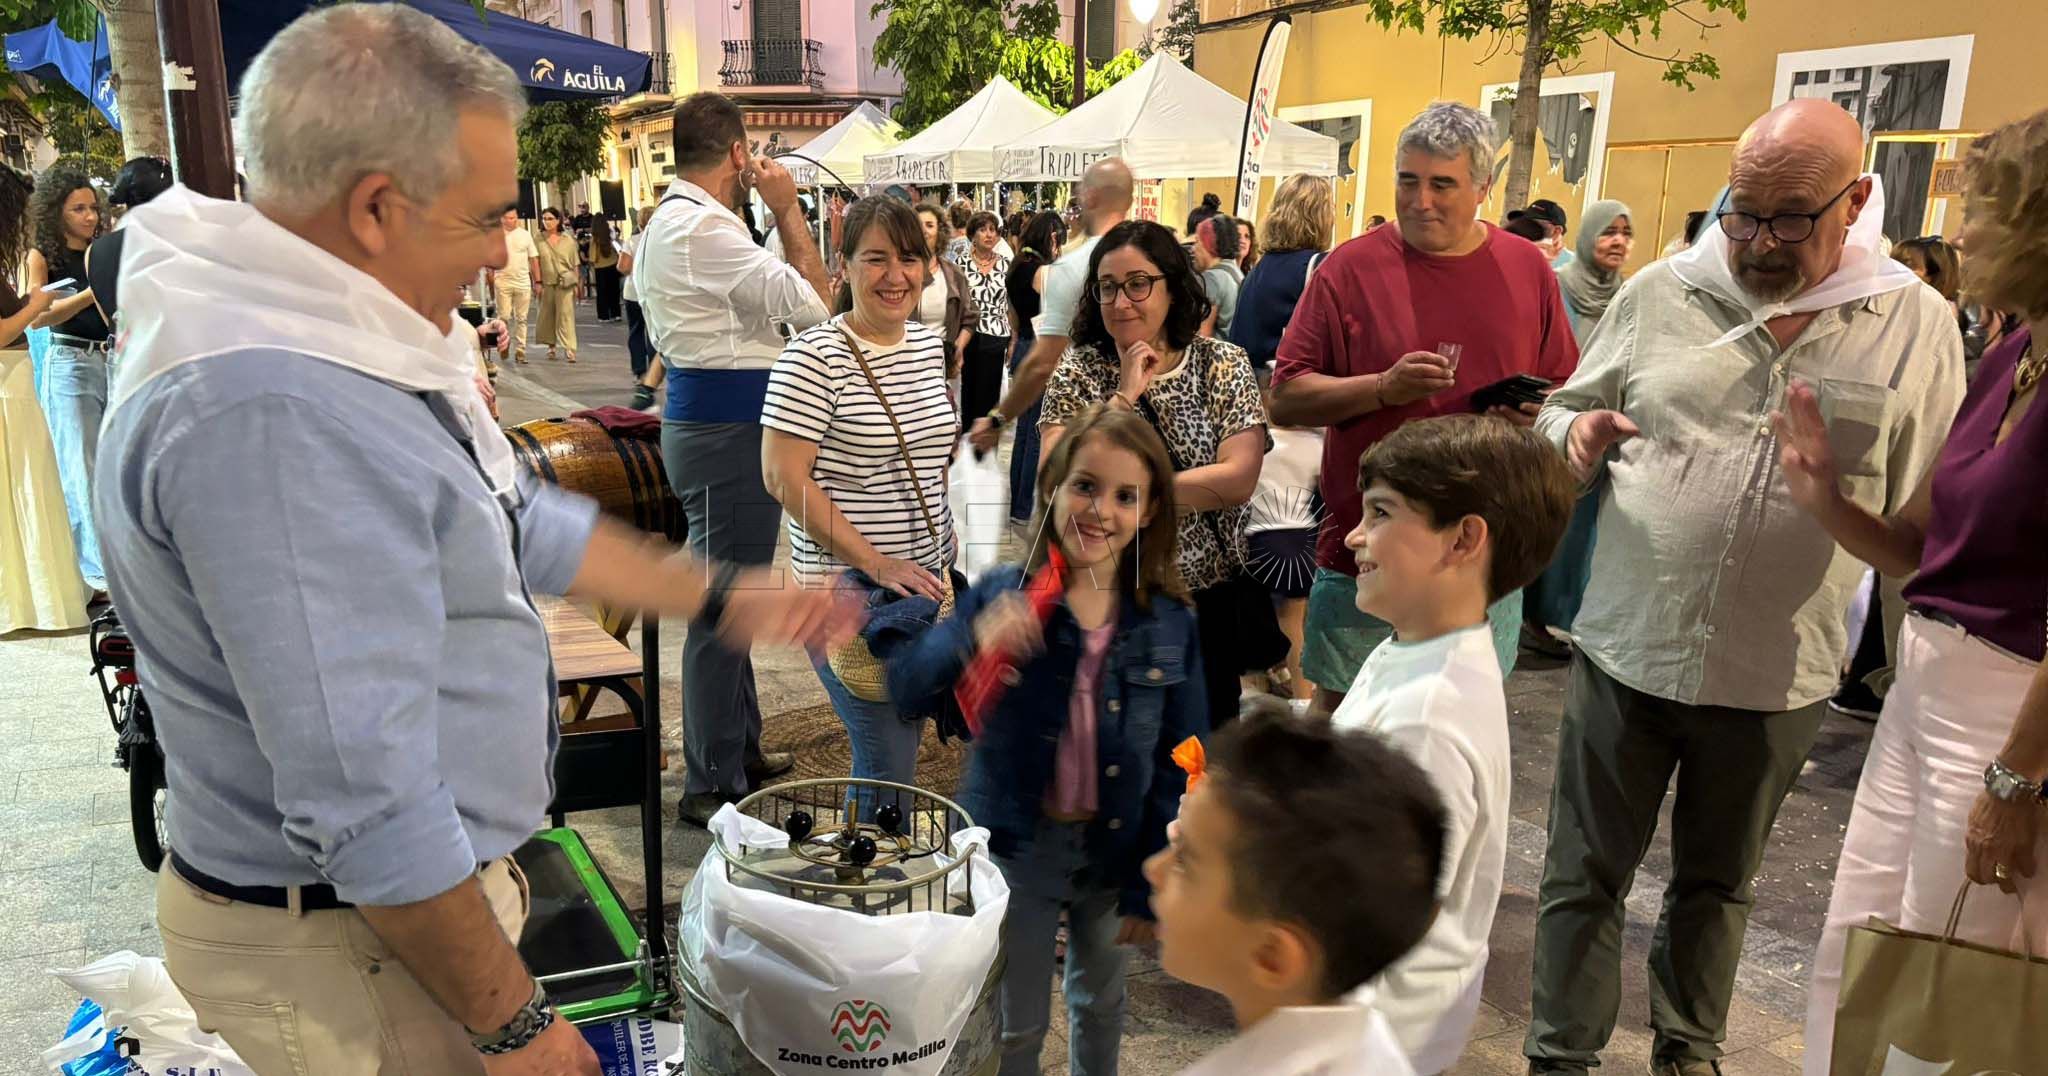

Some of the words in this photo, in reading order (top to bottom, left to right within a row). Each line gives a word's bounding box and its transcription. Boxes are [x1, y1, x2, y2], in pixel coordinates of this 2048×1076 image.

[563, 69, 626, 92] ÁGUILA
[594, 65, 604, 75] EL
[1039, 145, 1108, 176] TRIPLET
[778, 1048, 822, 1066] Zona
[826, 1055, 889, 1069] Centro
[892, 1039, 946, 1065] Melilla
